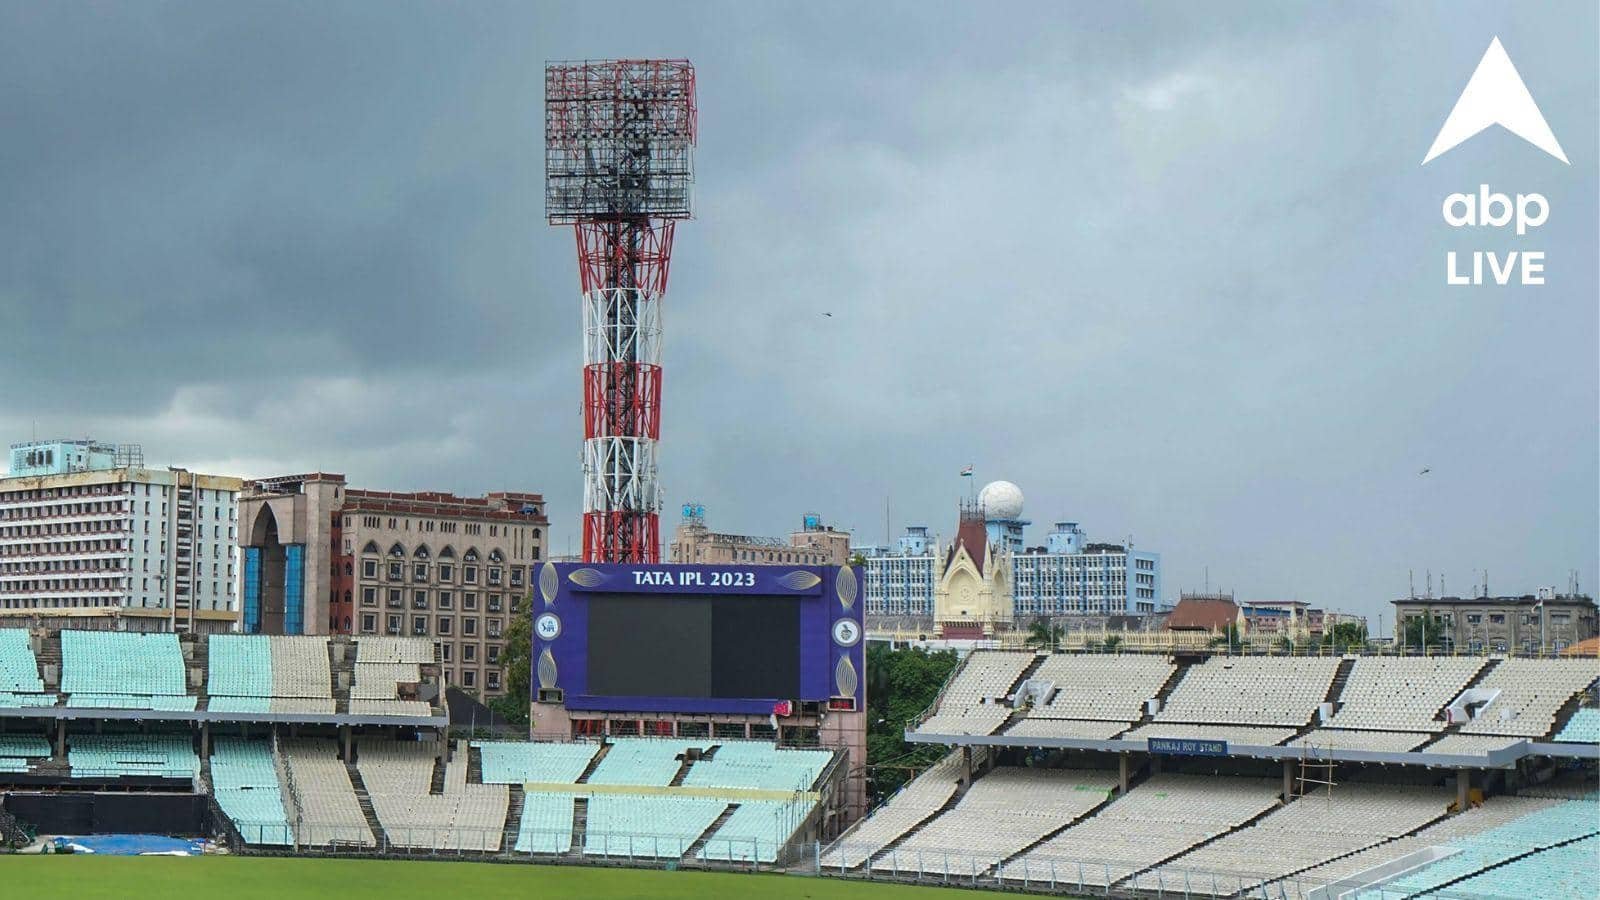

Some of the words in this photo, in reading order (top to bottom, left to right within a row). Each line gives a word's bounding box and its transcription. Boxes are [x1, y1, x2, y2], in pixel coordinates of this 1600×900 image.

[632, 571, 674, 585] TATA
[680, 571, 705, 586] IPL
[710, 572, 755, 586] 2023
[1151, 741, 1180, 751] PANKAJ
[1182, 742, 1197, 752] ROY
[1200, 743, 1223, 753] STAND
